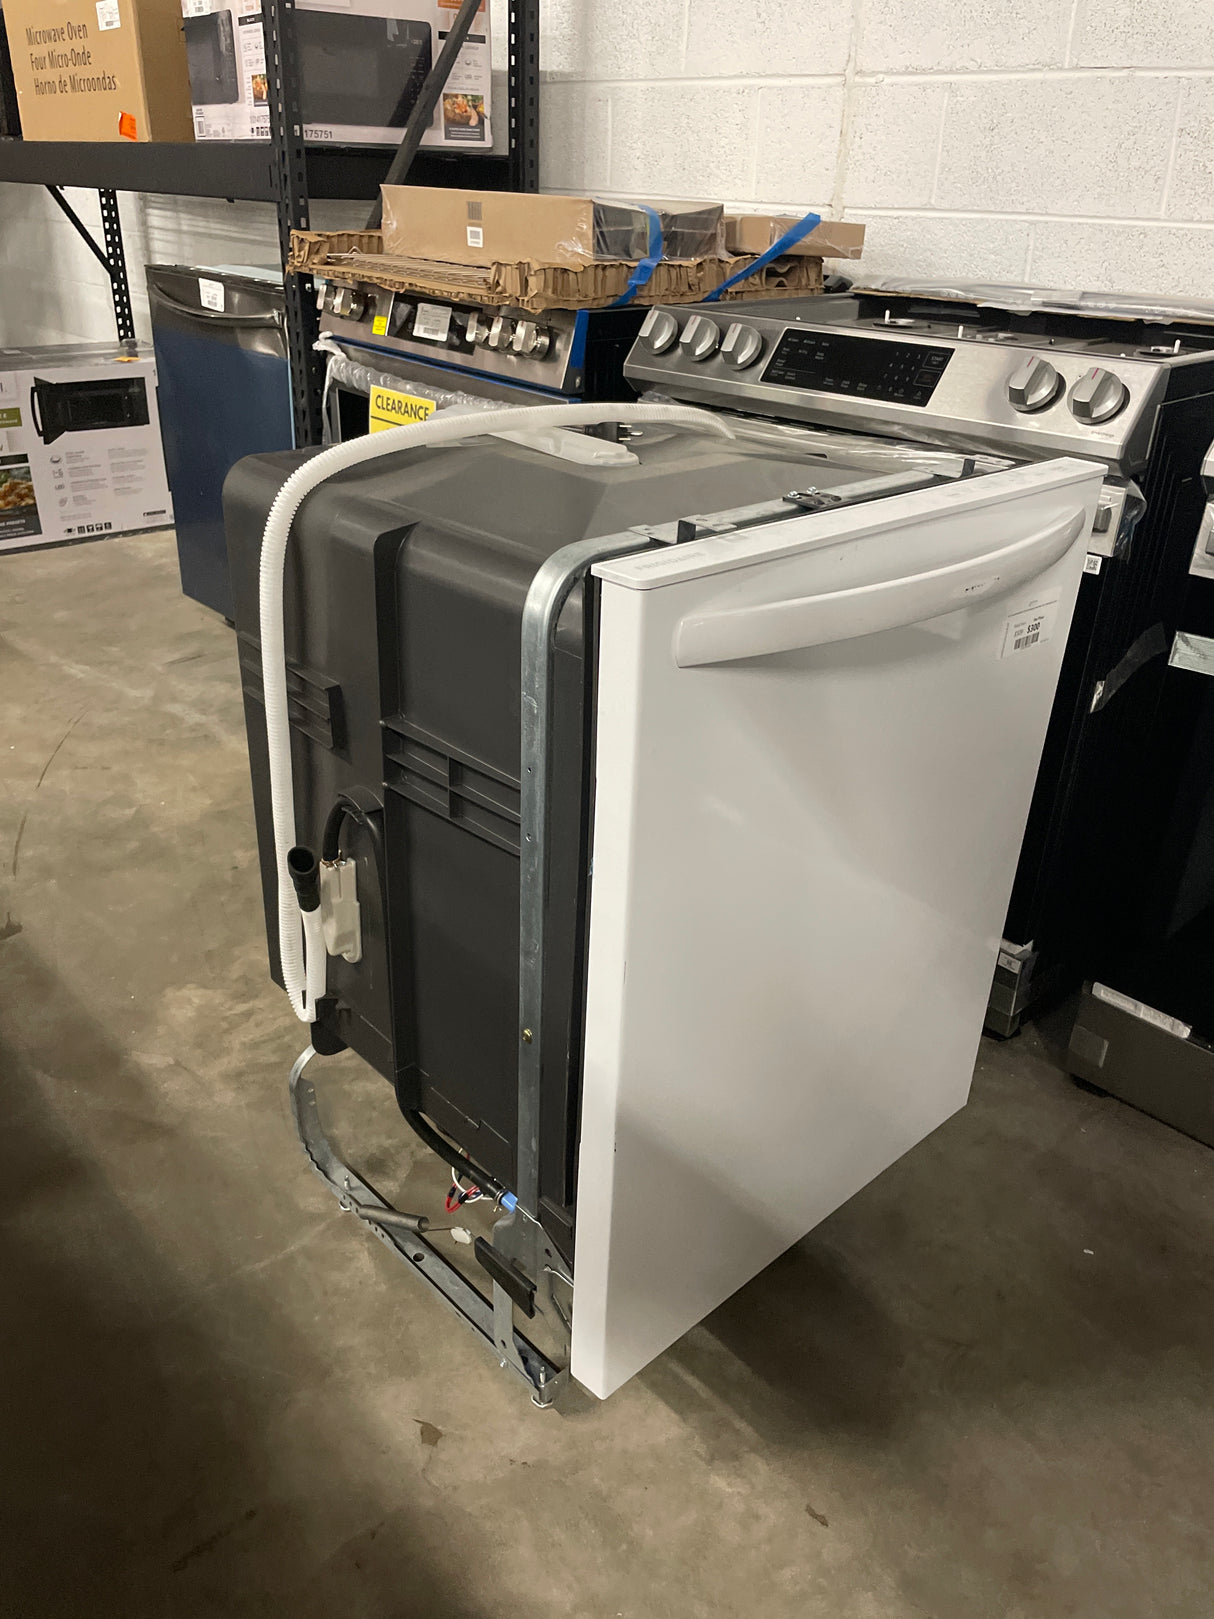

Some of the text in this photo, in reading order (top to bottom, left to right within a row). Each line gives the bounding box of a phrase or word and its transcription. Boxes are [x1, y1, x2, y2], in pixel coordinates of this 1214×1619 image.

[25, 21, 89, 46] Microwave Oven
[29, 45, 92, 72] Four Micro-Onde
[33, 70, 117, 96] Horno de Microondas
[375, 395, 430, 421] CLEARANCE
